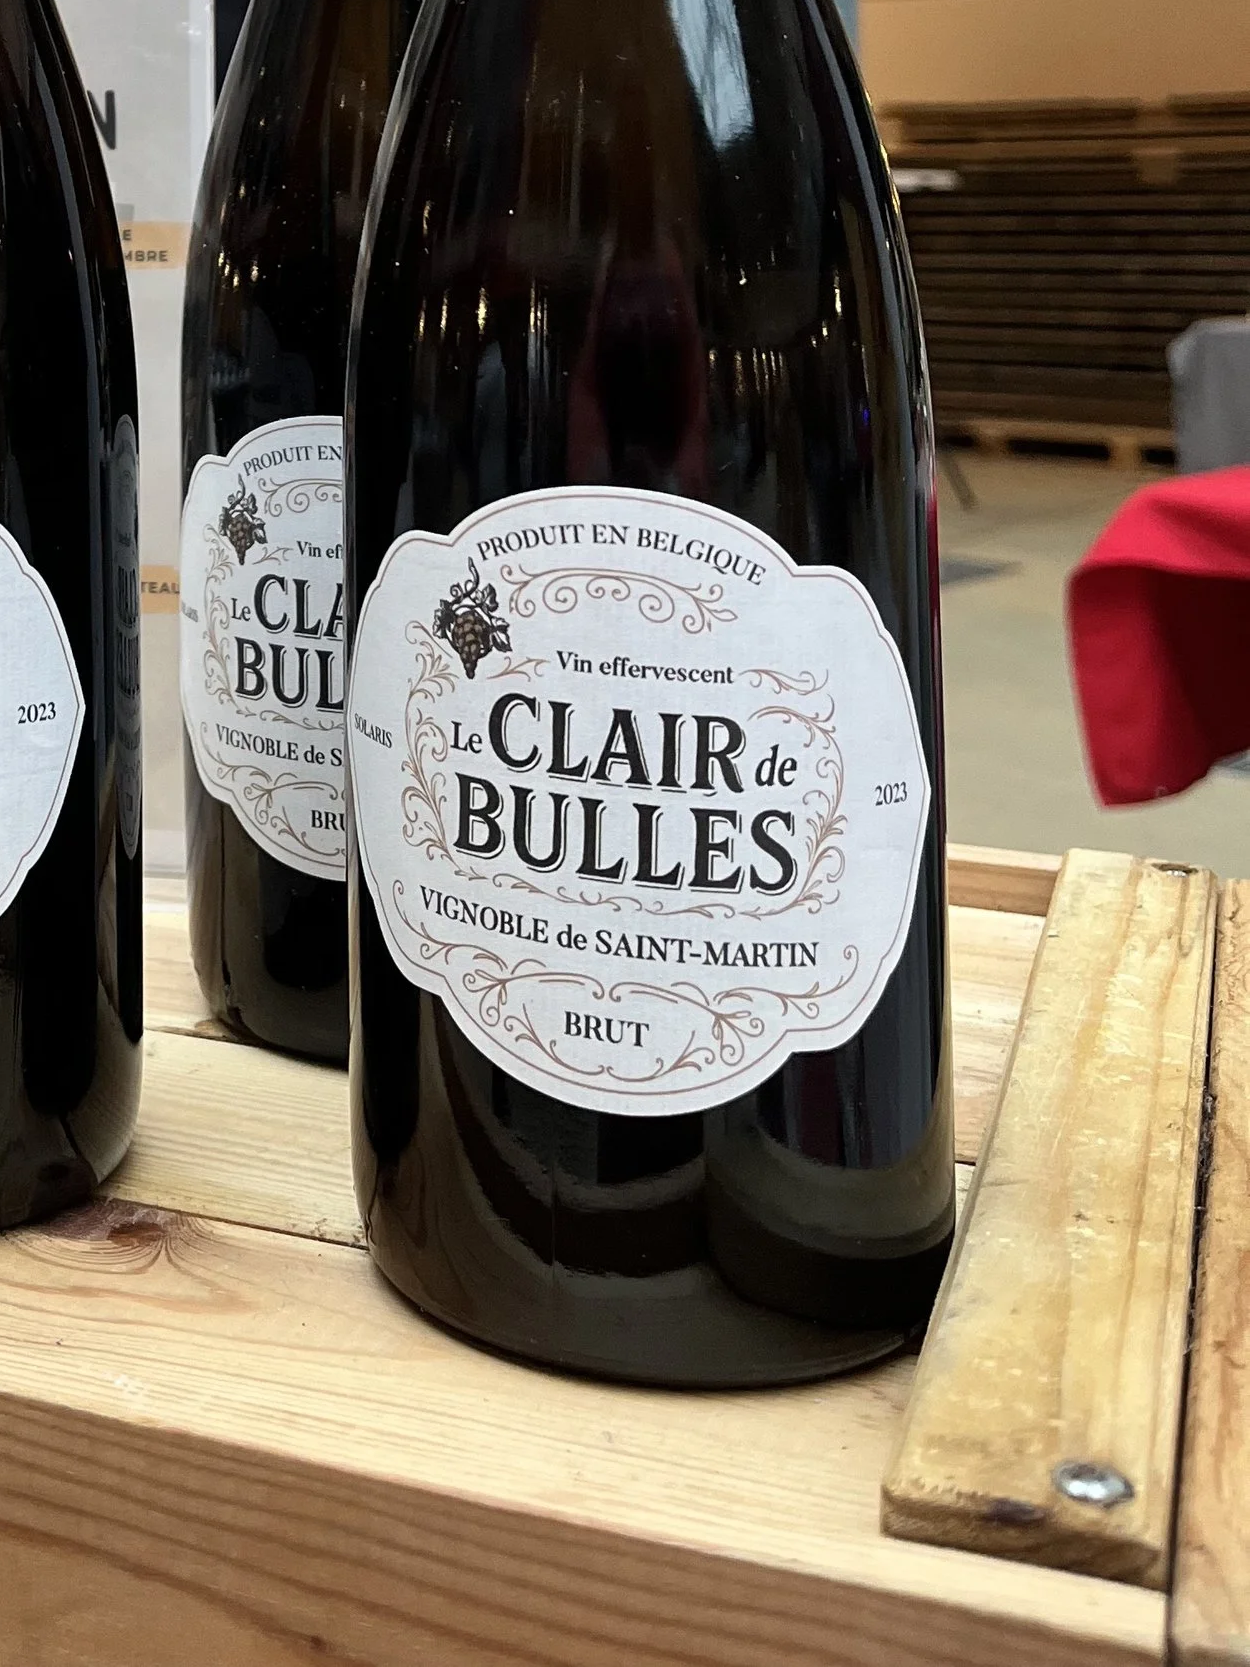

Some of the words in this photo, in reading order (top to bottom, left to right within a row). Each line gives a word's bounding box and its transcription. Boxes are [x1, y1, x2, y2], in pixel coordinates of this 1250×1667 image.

[243, 445, 313, 477] PRODUIT
[296, 541, 322, 558] Vin
[477, 523, 585, 562] PRODUIT
[591, 524, 628, 545] EN
[637, 528, 766, 586] BELGIQUE
[231, 597, 251, 621] Le
[555, 650, 593, 674] Vin
[599, 656, 735, 684] effervescent
[17, 701, 56, 725] 2023
[354, 712, 393, 749] SOLARIS
[216, 723, 299, 761] VIGNOBLE
[304, 745, 326, 765] de
[450, 720, 484, 755] Le
[487, 691, 751, 798] CLAIR
[755, 743, 798, 788] de
[874, 781, 908, 807] 2023
[453, 771, 798, 895] BULLES
[419, 885, 549, 945] VIGNOBLE
[556, 925, 589, 951] de
[595, 929, 820, 968] SAINT-MARTIN
[563, 1010, 651, 1047] BRUT
